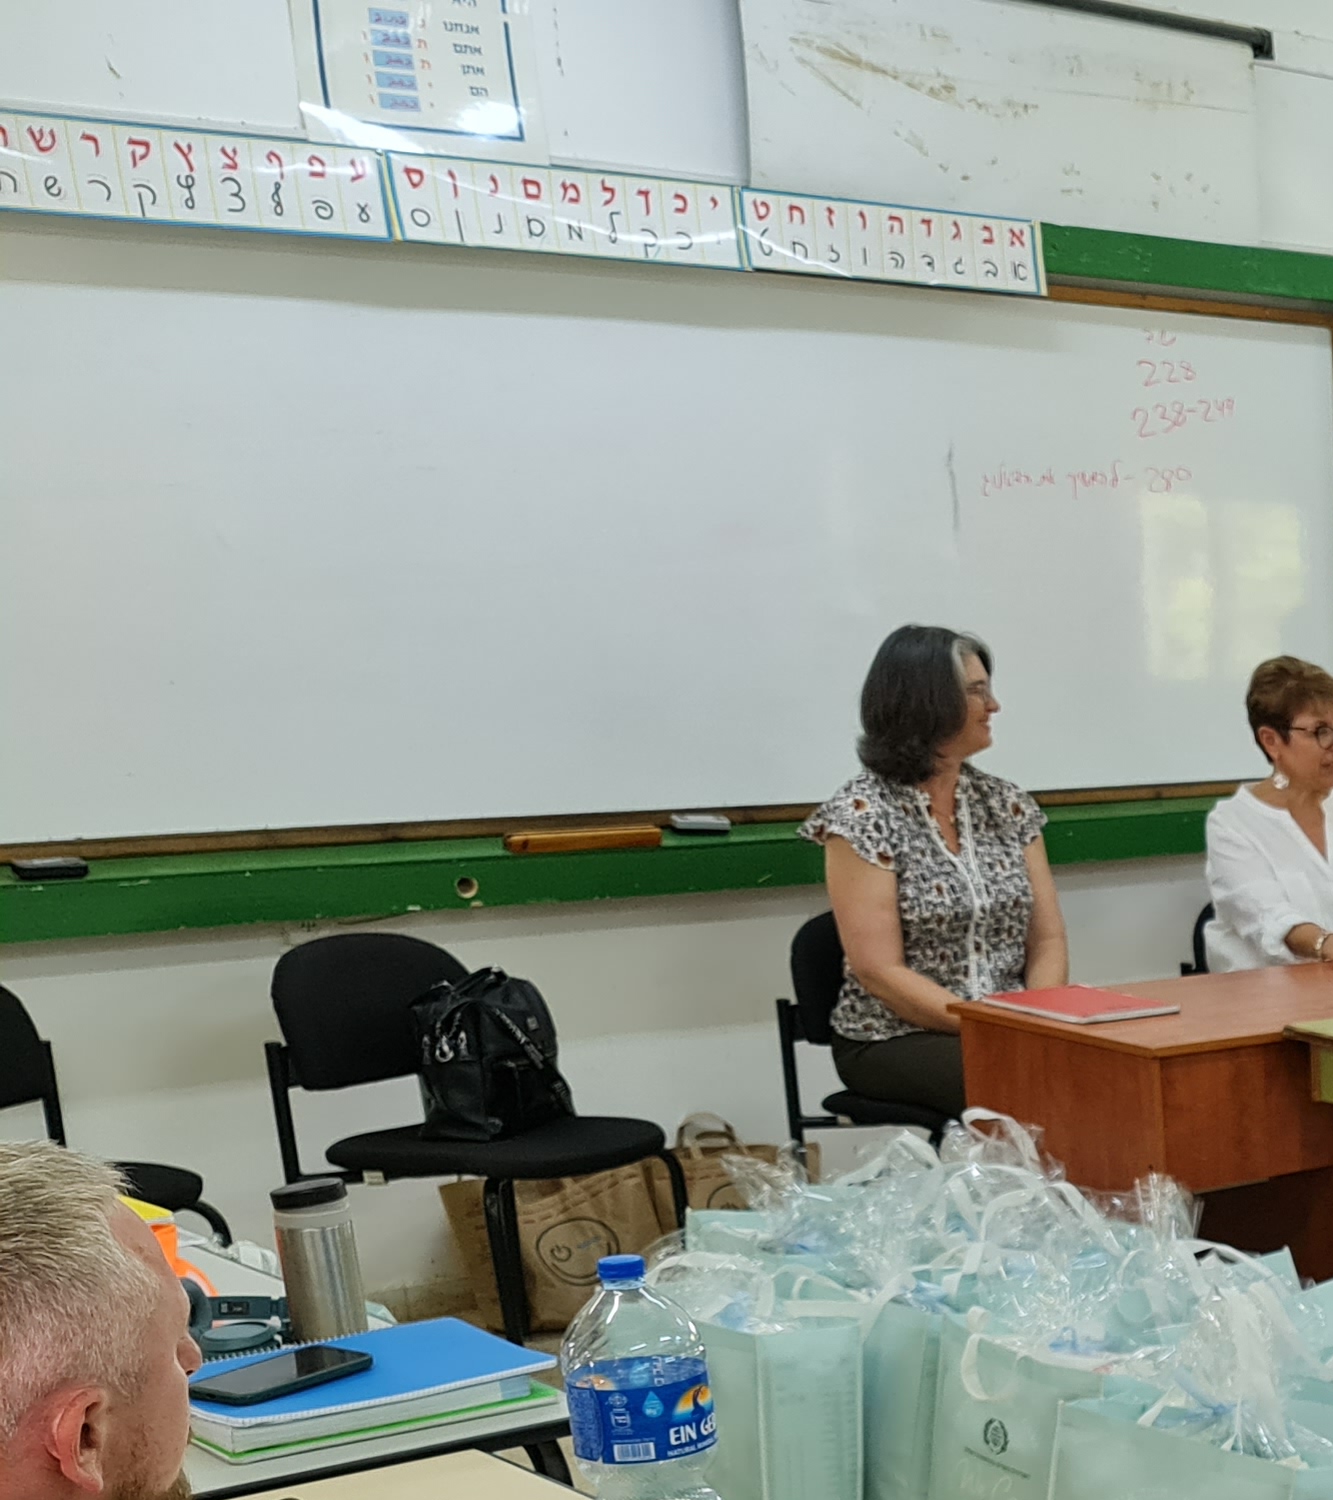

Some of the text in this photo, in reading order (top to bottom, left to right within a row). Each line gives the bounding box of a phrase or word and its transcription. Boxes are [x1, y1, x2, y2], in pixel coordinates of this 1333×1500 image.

[442, 20, 480, 35] אנחנו
[452, 42, 483, 56] אתם
[461, 63, 486, 76] אתן
[468, 86, 489, 97] הם
[26, 123, 57, 153] ש
[80, 132, 100, 157] ר
[126, 136, 152, 168] ק
[173, 140, 196, 173] ץ
[218, 145, 239, 171] צ
[265, 150, 285, 180] ף
[307, 154, 327, 178] פ
[349, 157, 367, 183] ע
[402, 166, 425, 189] ס
[488, 174, 500, 198] נ
[521, 178, 542, 201] ם
[560, 181, 582, 204] מ
[600, 178, 617, 207] ל
[636, 188, 652, 217] ך
[673, 192, 689, 214] כ
[709, 195, 719, 211] י
[752, 198, 771, 221] ט
[788, 204, 806, 226] ח
[888, 215, 905, 235] ה
[920, 218, 933, 237] ד
[950, 220, 963, 241] ג
[981, 224, 995, 245] ב
[1009, 227, 1026, 248] א
[1137, 358, 1197, 387] 228
[669, 1422, 697, 1446] EIN
